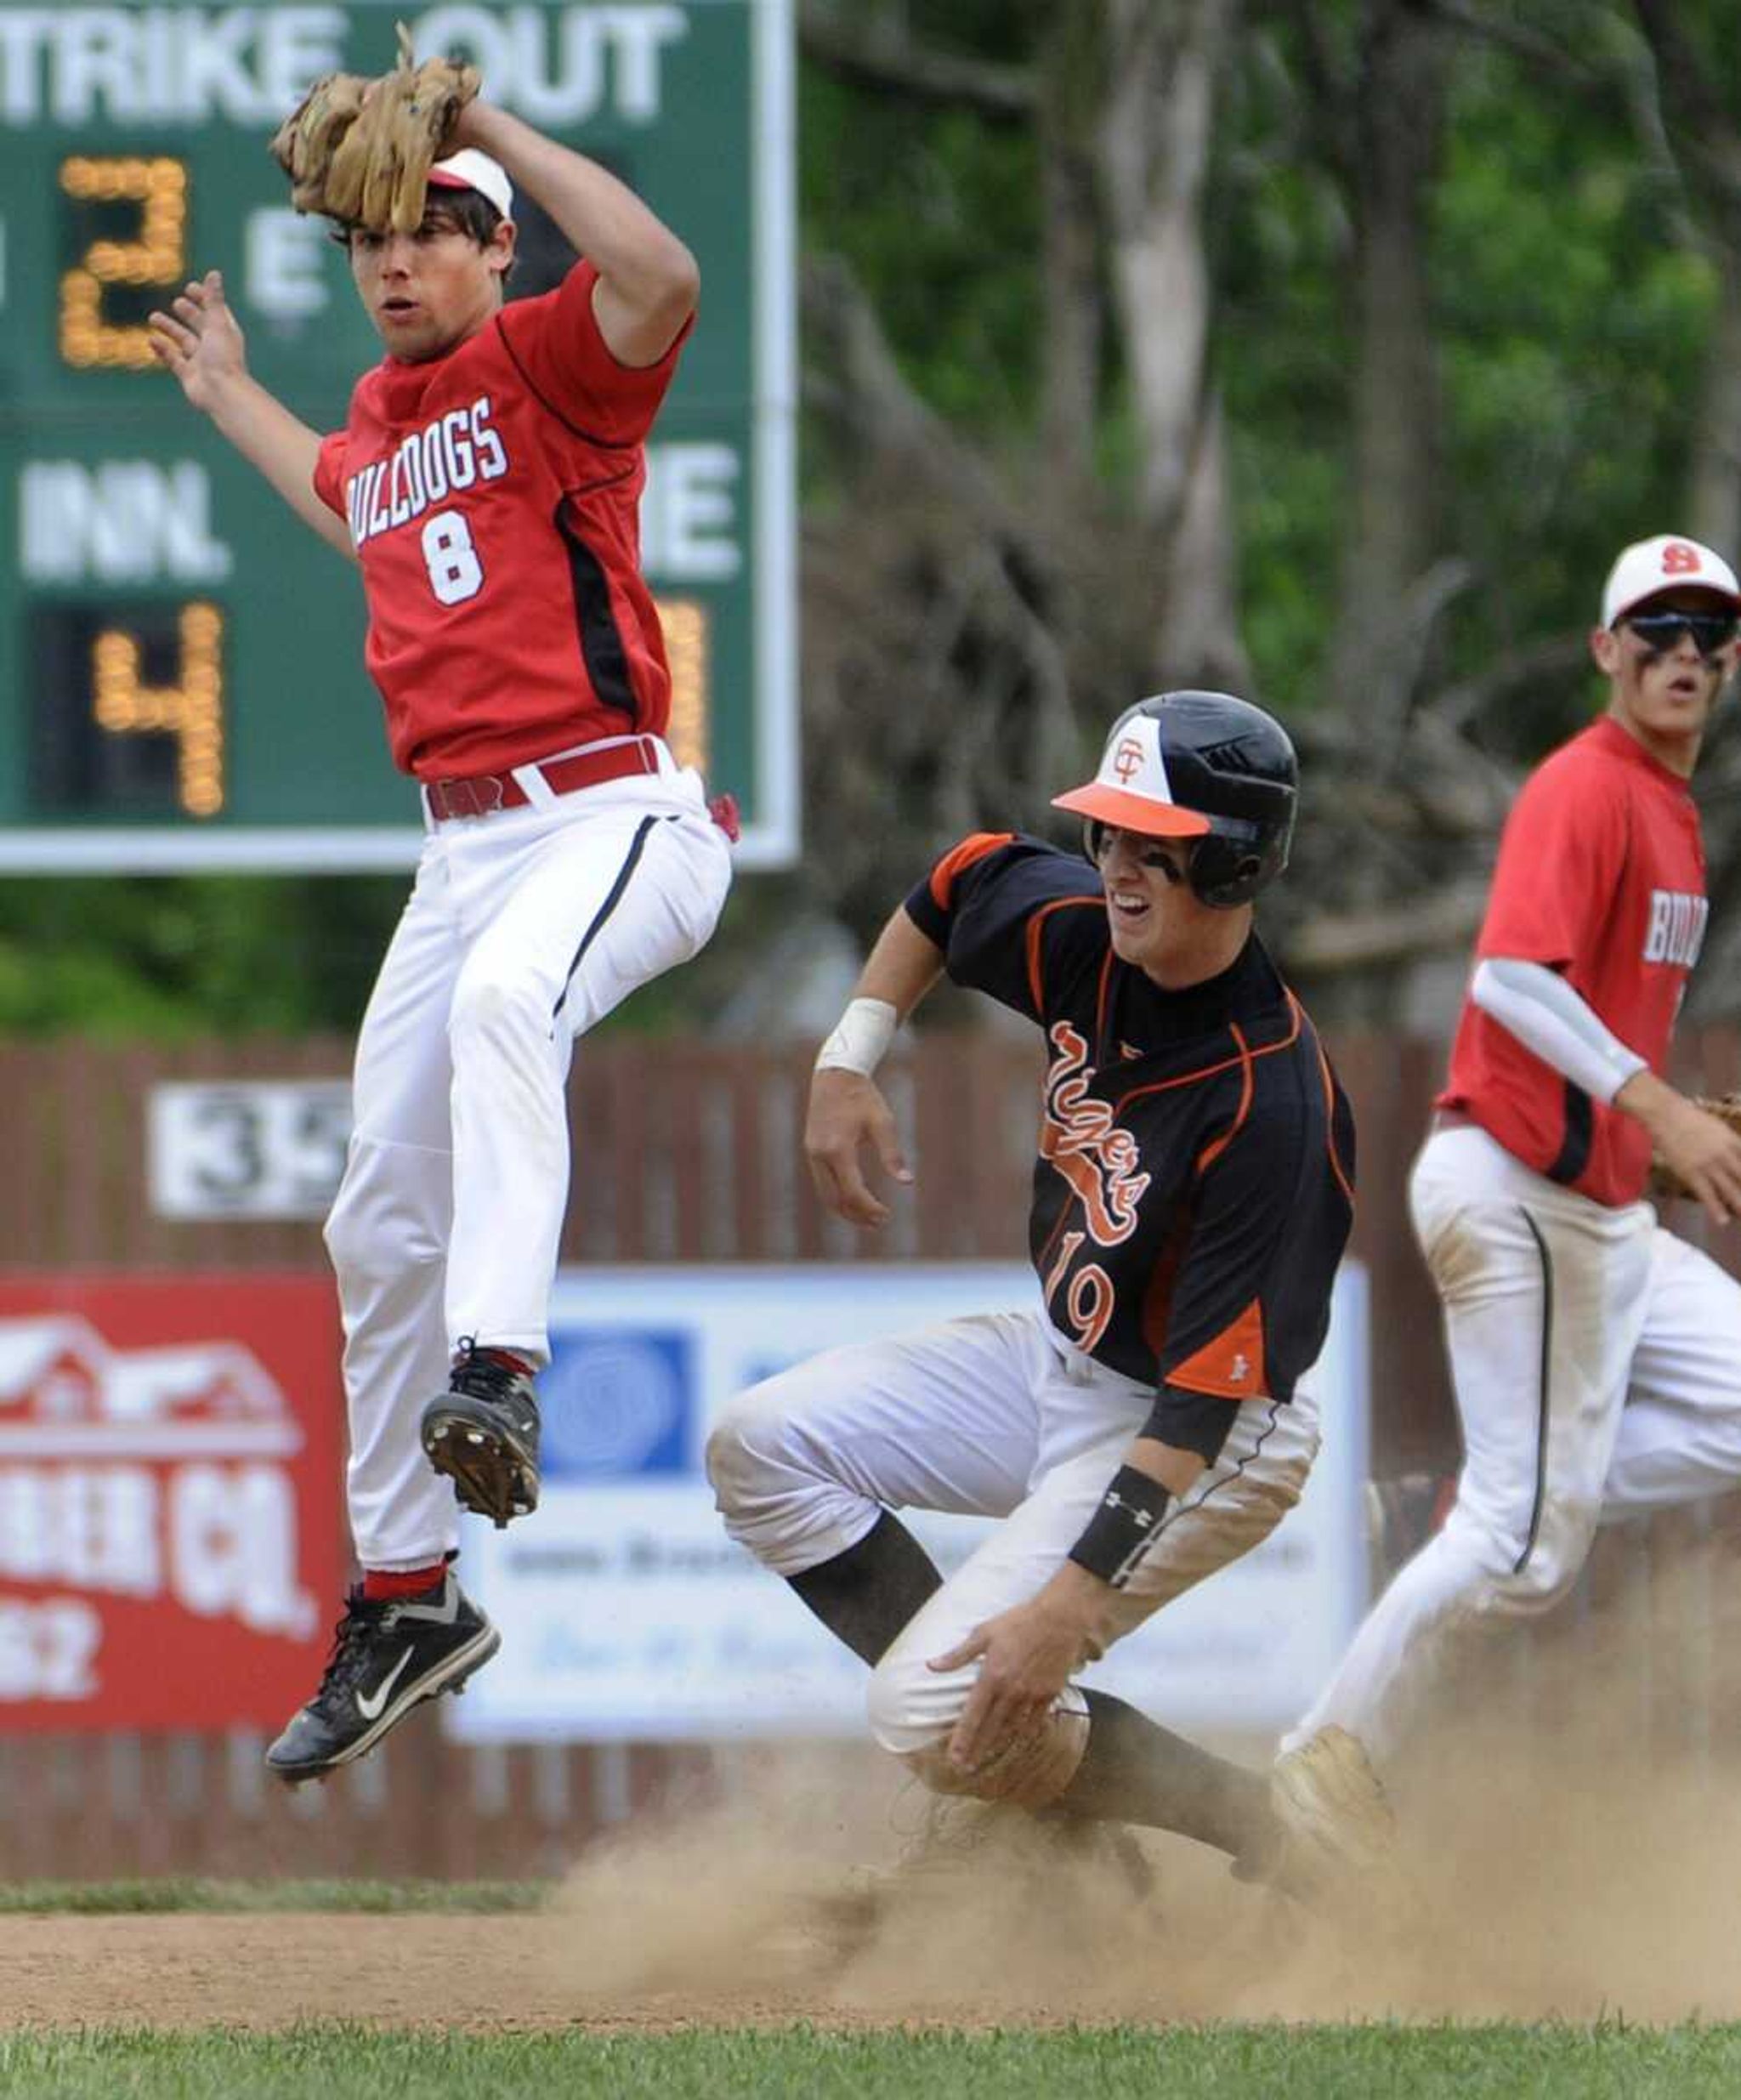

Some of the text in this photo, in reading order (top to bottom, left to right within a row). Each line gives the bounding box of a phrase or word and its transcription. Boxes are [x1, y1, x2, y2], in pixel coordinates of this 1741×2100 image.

[405, 7, 684, 126] OUT
[60, 155, 187, 371] 2
[421, 508, 485, 607] 8
[1661, 541, 1704, 576] S
[92, 600, 224, 818] 4
[1040, 1020, 1151, 1247] Tigers
[1043, 1230, 1115, 1354] 19
